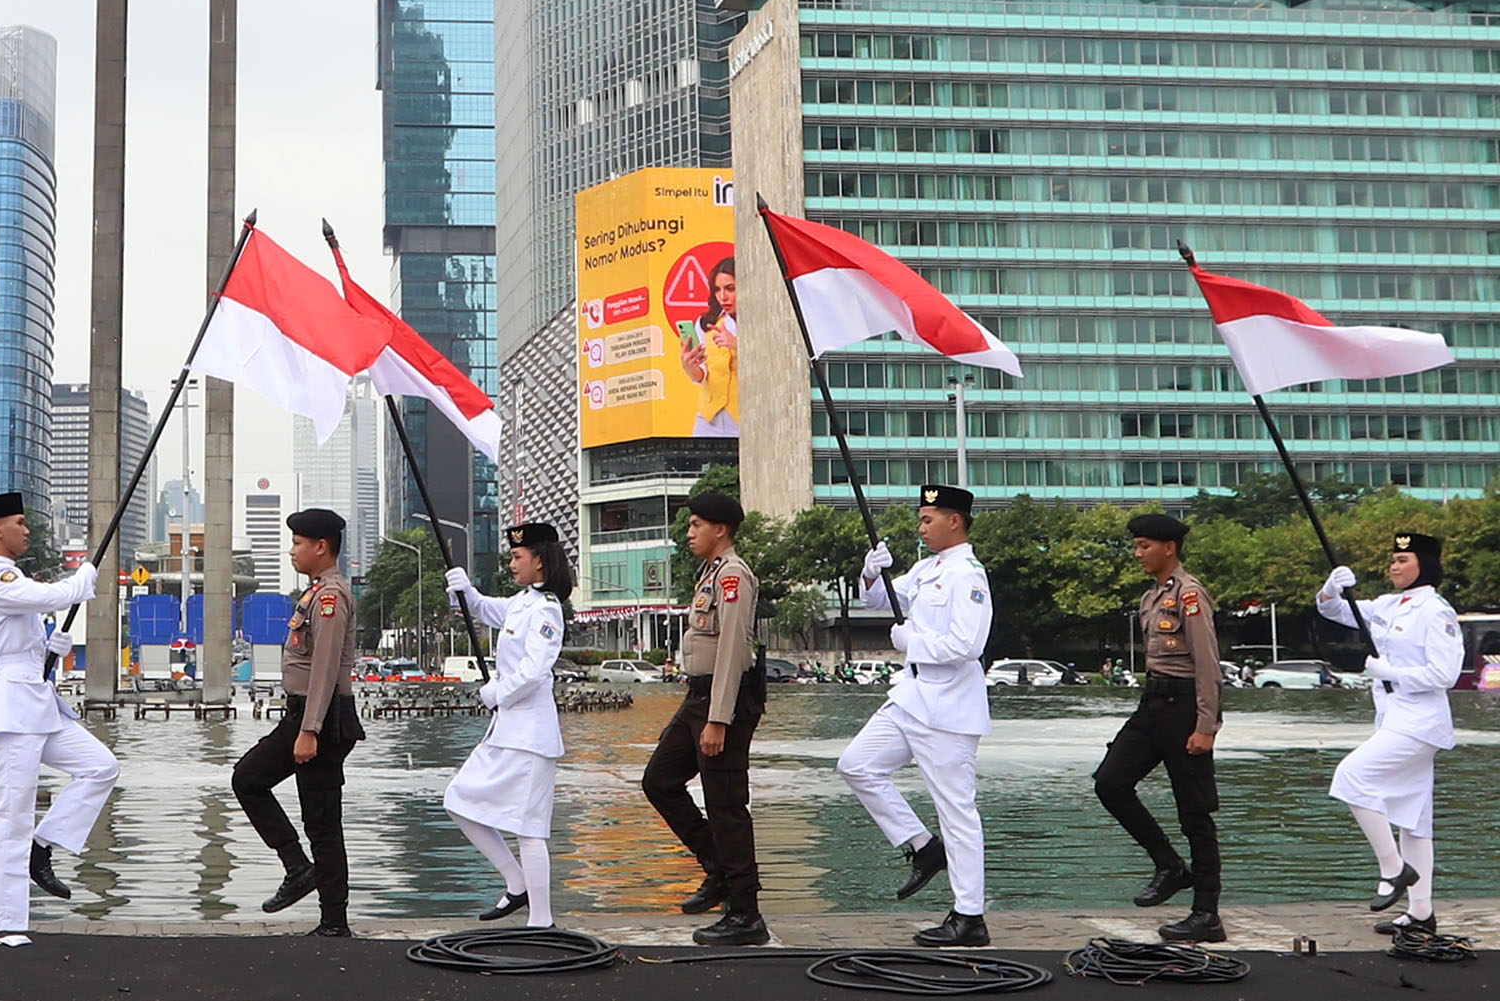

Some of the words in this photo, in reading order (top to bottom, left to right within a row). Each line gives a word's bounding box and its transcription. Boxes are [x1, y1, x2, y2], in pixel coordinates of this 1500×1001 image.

[655, 187, 692, 198] Simpel
[694, 187, 708, 197] itu
[584, 229, 615, 249] Sering
[617, 216, 684, 239] Dihubungi
[585, 252, 617, 270] Nomor
[619, 239, 666, 260] Modus?
